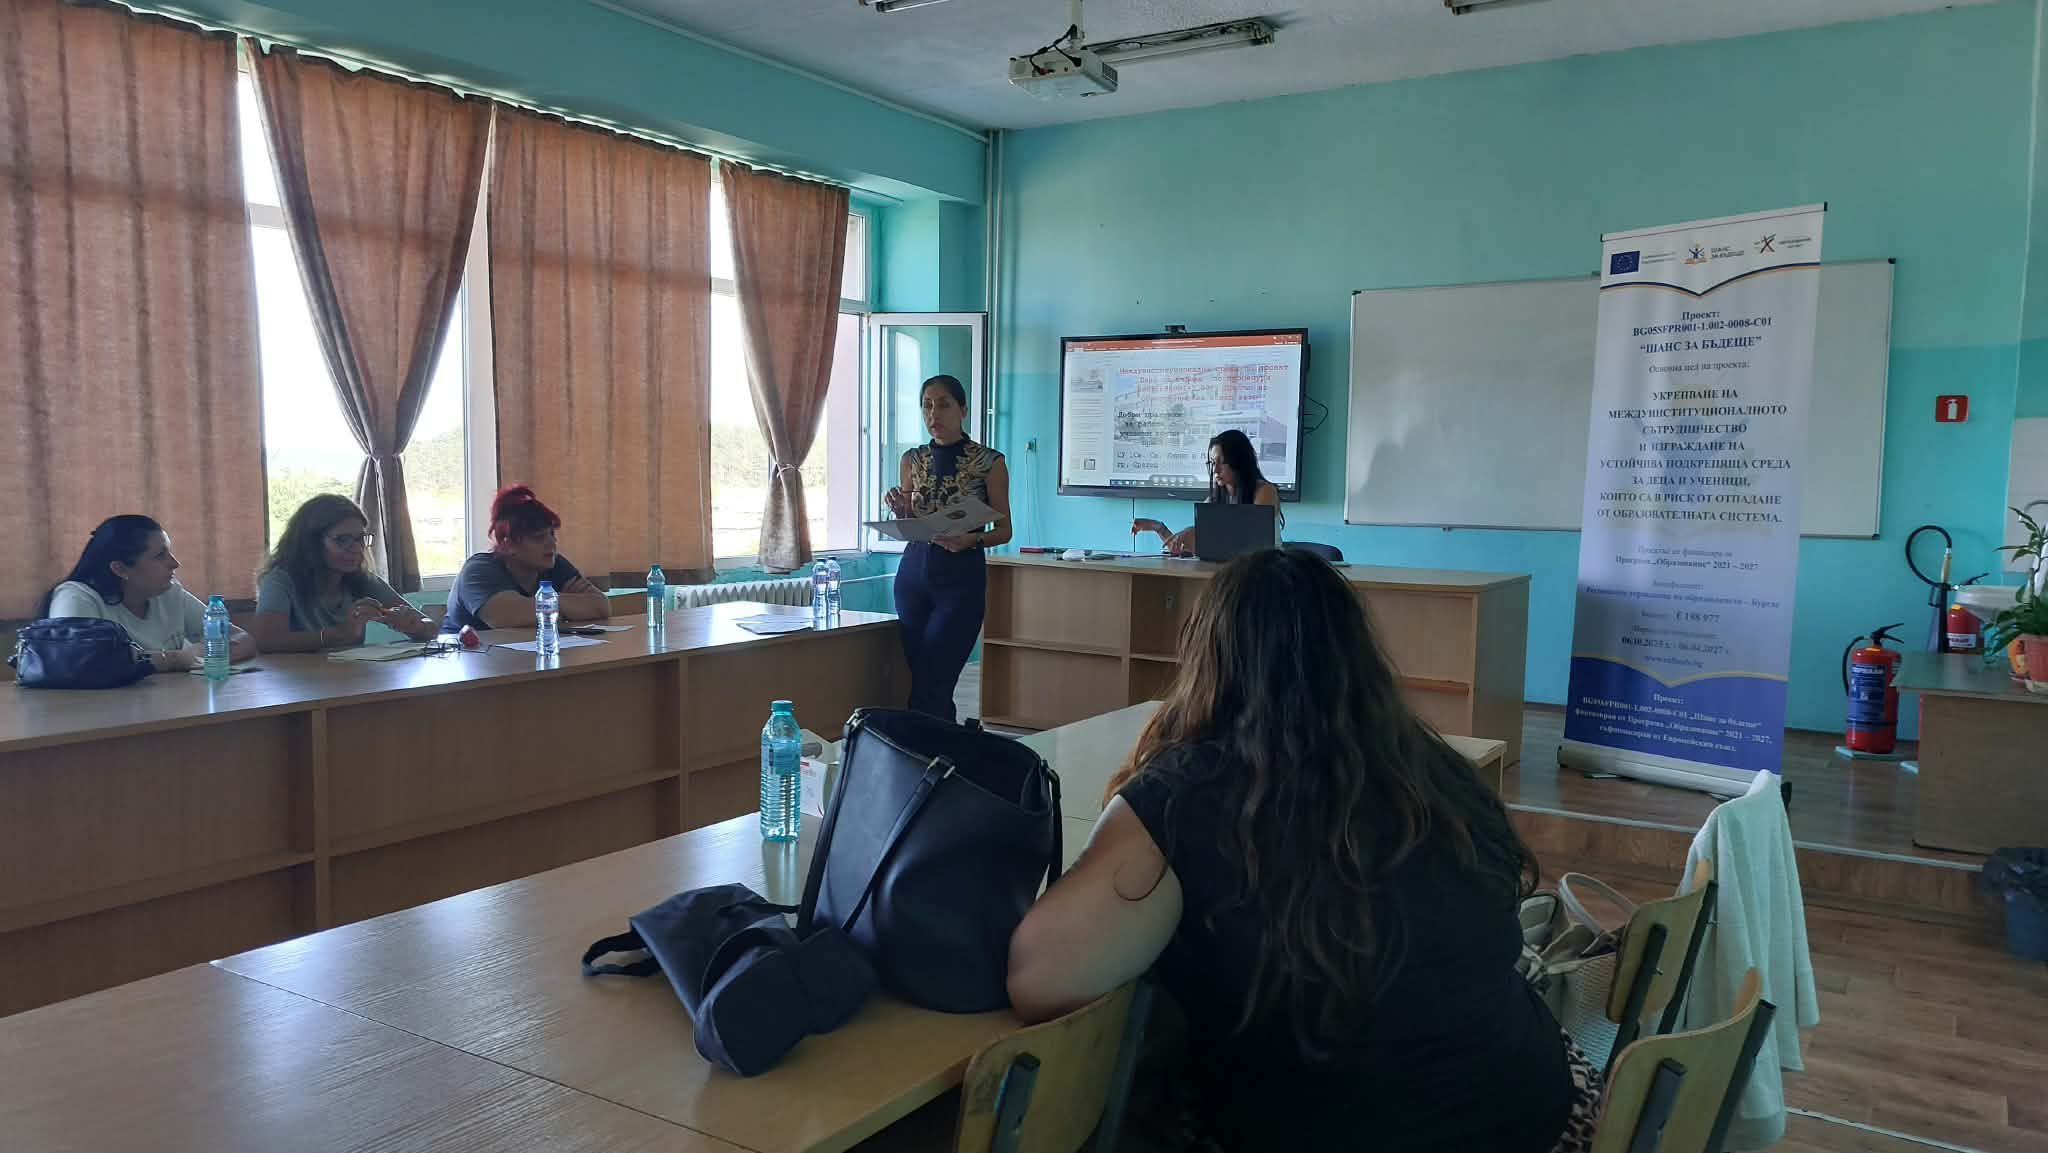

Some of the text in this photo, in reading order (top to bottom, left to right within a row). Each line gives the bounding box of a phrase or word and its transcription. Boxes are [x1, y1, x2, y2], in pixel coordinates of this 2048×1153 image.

[1682, 311, 1720, 322] Проект:
[1684, 340, 1699, 350] ЗА
[1653, 388, 1739, 400] УКРЕПВАНЕ НА
[1729, 441, 1745, 451] НА
[1600, 457, 1664, 469] УСТОЙЧИВА
[1752, 459, 1791, 470] СРЕДА
[1632, 476, 1645, 485] ЗА
[1639, 493, 1652, 502] СА
[1663, 494, 1696, 503] РИСК
[1697, 494, 1712, 504] ОТ
[1715, 495, 1782, 505] ОТПАДАНЕ
